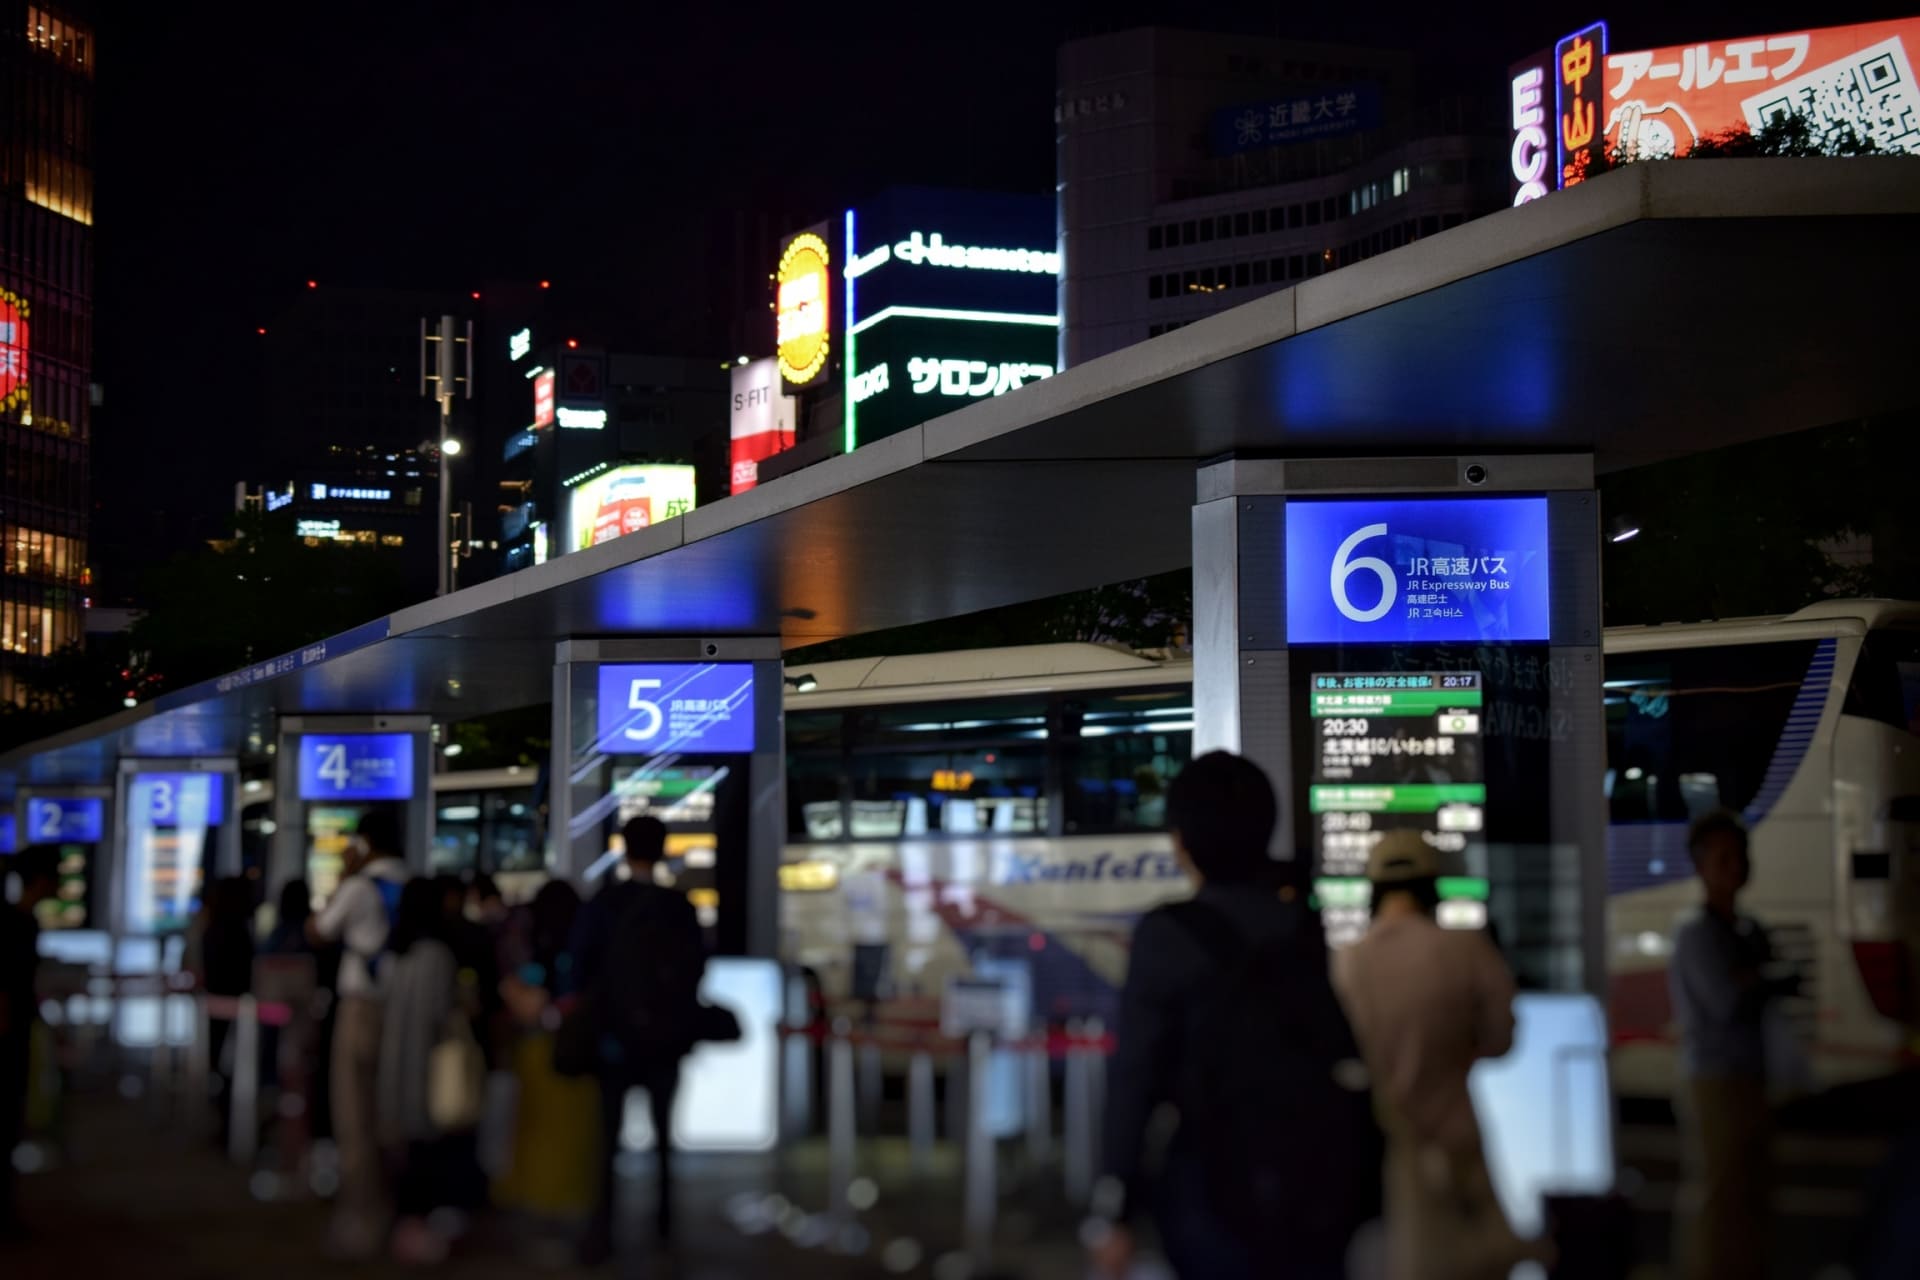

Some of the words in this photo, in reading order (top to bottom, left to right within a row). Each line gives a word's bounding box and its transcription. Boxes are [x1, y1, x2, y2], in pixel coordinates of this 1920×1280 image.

[1607, 34, 1810, 99] アールエフ
[1563, 36, 1596, 150] 中山
[1330, 522, 1397, 622] 6
[1406, 556, 1508, 576] JR高速バス
[1407, 580, 1420, 591] JR
[1422, 580, 1487, 592] Expressway
[1490, 579, 1510, 590] Bus
[1408, 608, 1420, 618] JR
[1442, 676, 1472, 688] 20:17
[624, 679, 663, 740] 5
[1323, 718, 1368, 736] 20:30
[317, 743, 351, 790] 4
[152, 780, 172, 820] 3
[41, 803, 62, 837] 2
